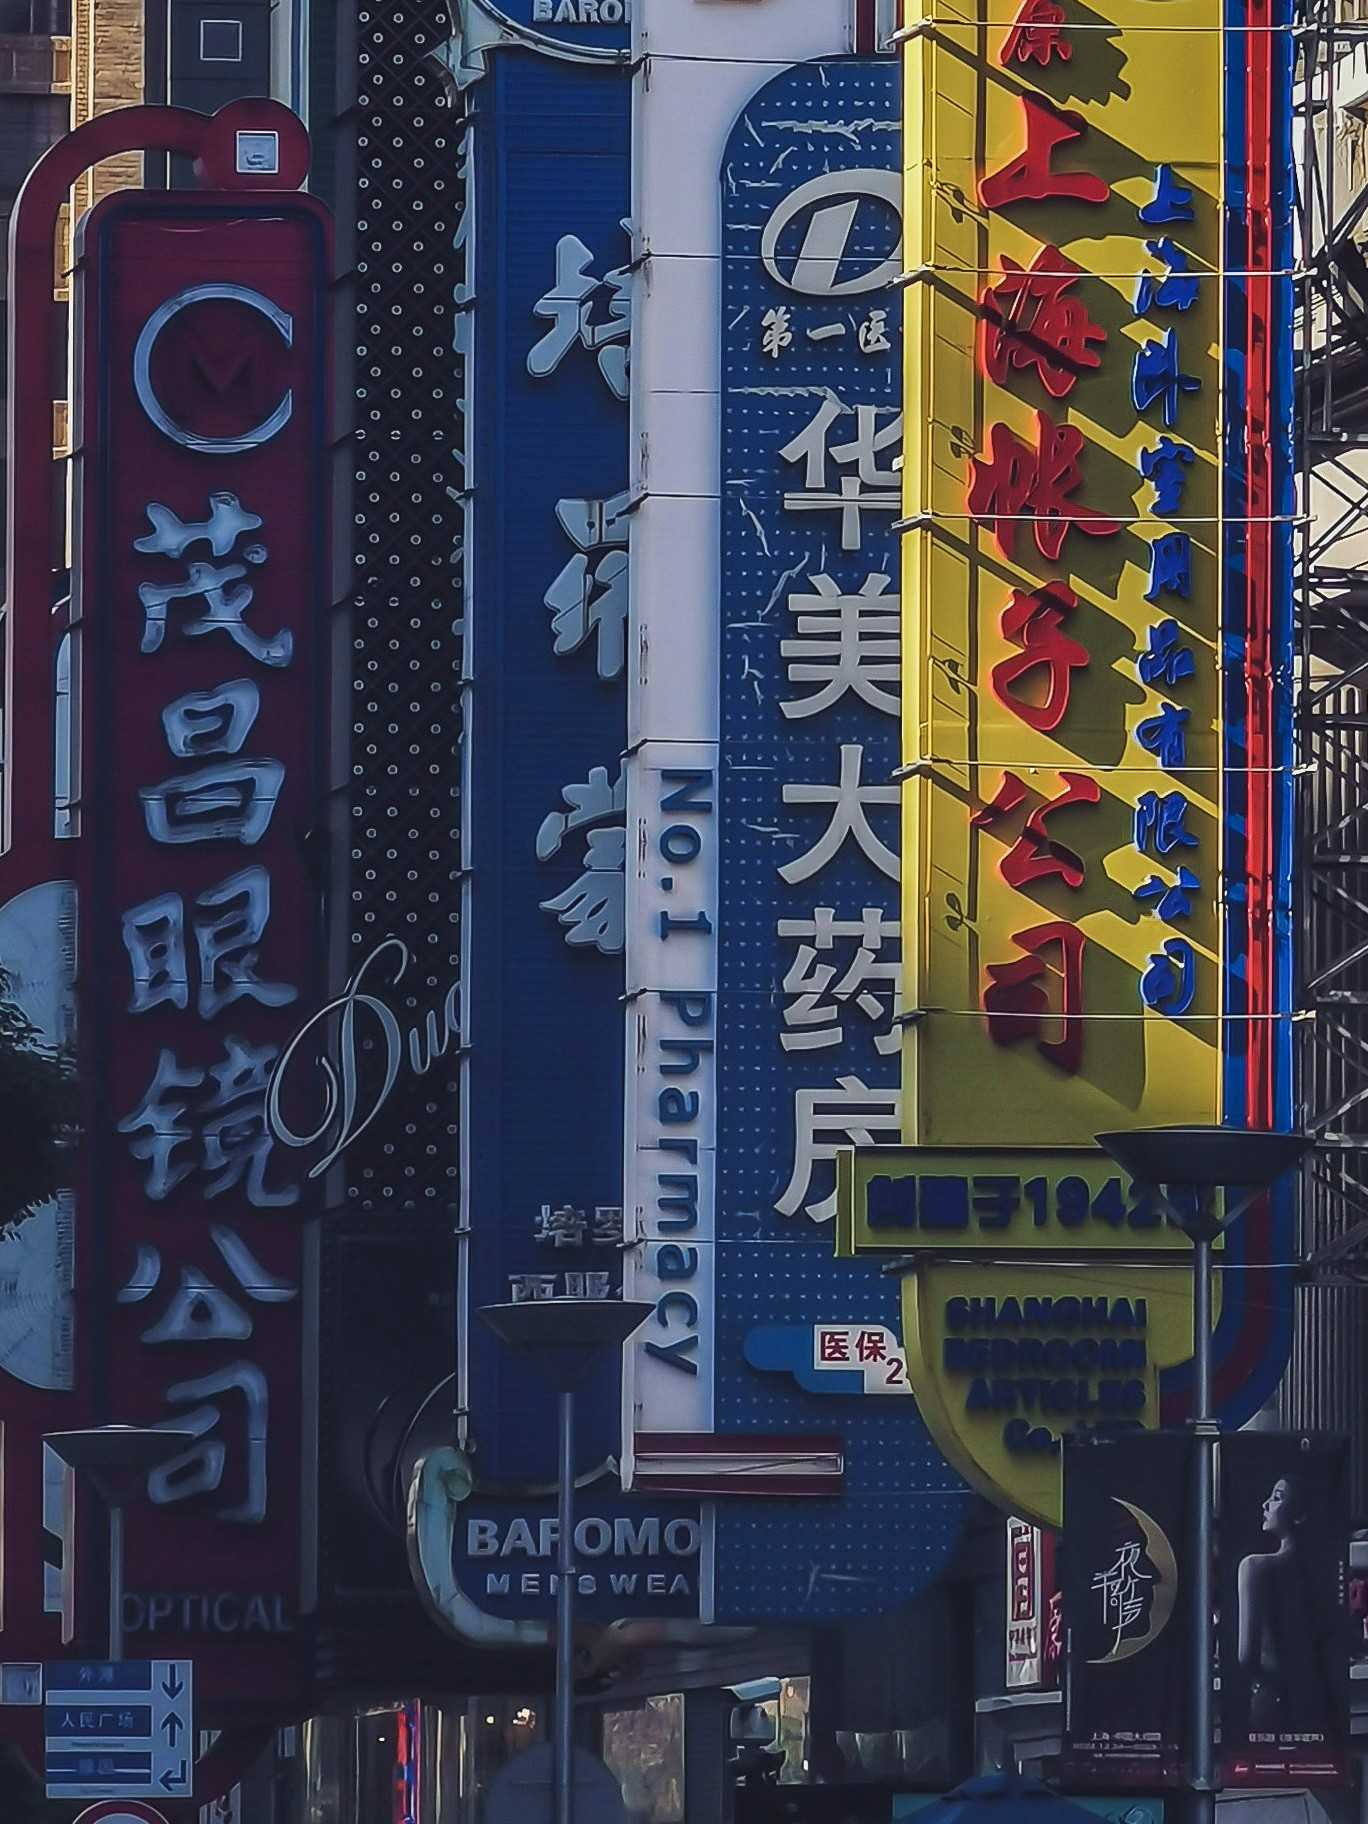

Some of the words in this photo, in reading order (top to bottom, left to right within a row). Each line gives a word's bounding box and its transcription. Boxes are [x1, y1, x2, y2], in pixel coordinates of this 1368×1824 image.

[117, 491, 299, 1523] 茂昌眼镜公司
[646, 995, 713, 1375] Pharmacy
[820, 1330, 887, 1363] 医保
[121, 1591, 294, 1633] OPTICAL
[61, 1712, 135, 1730] 人民广场
